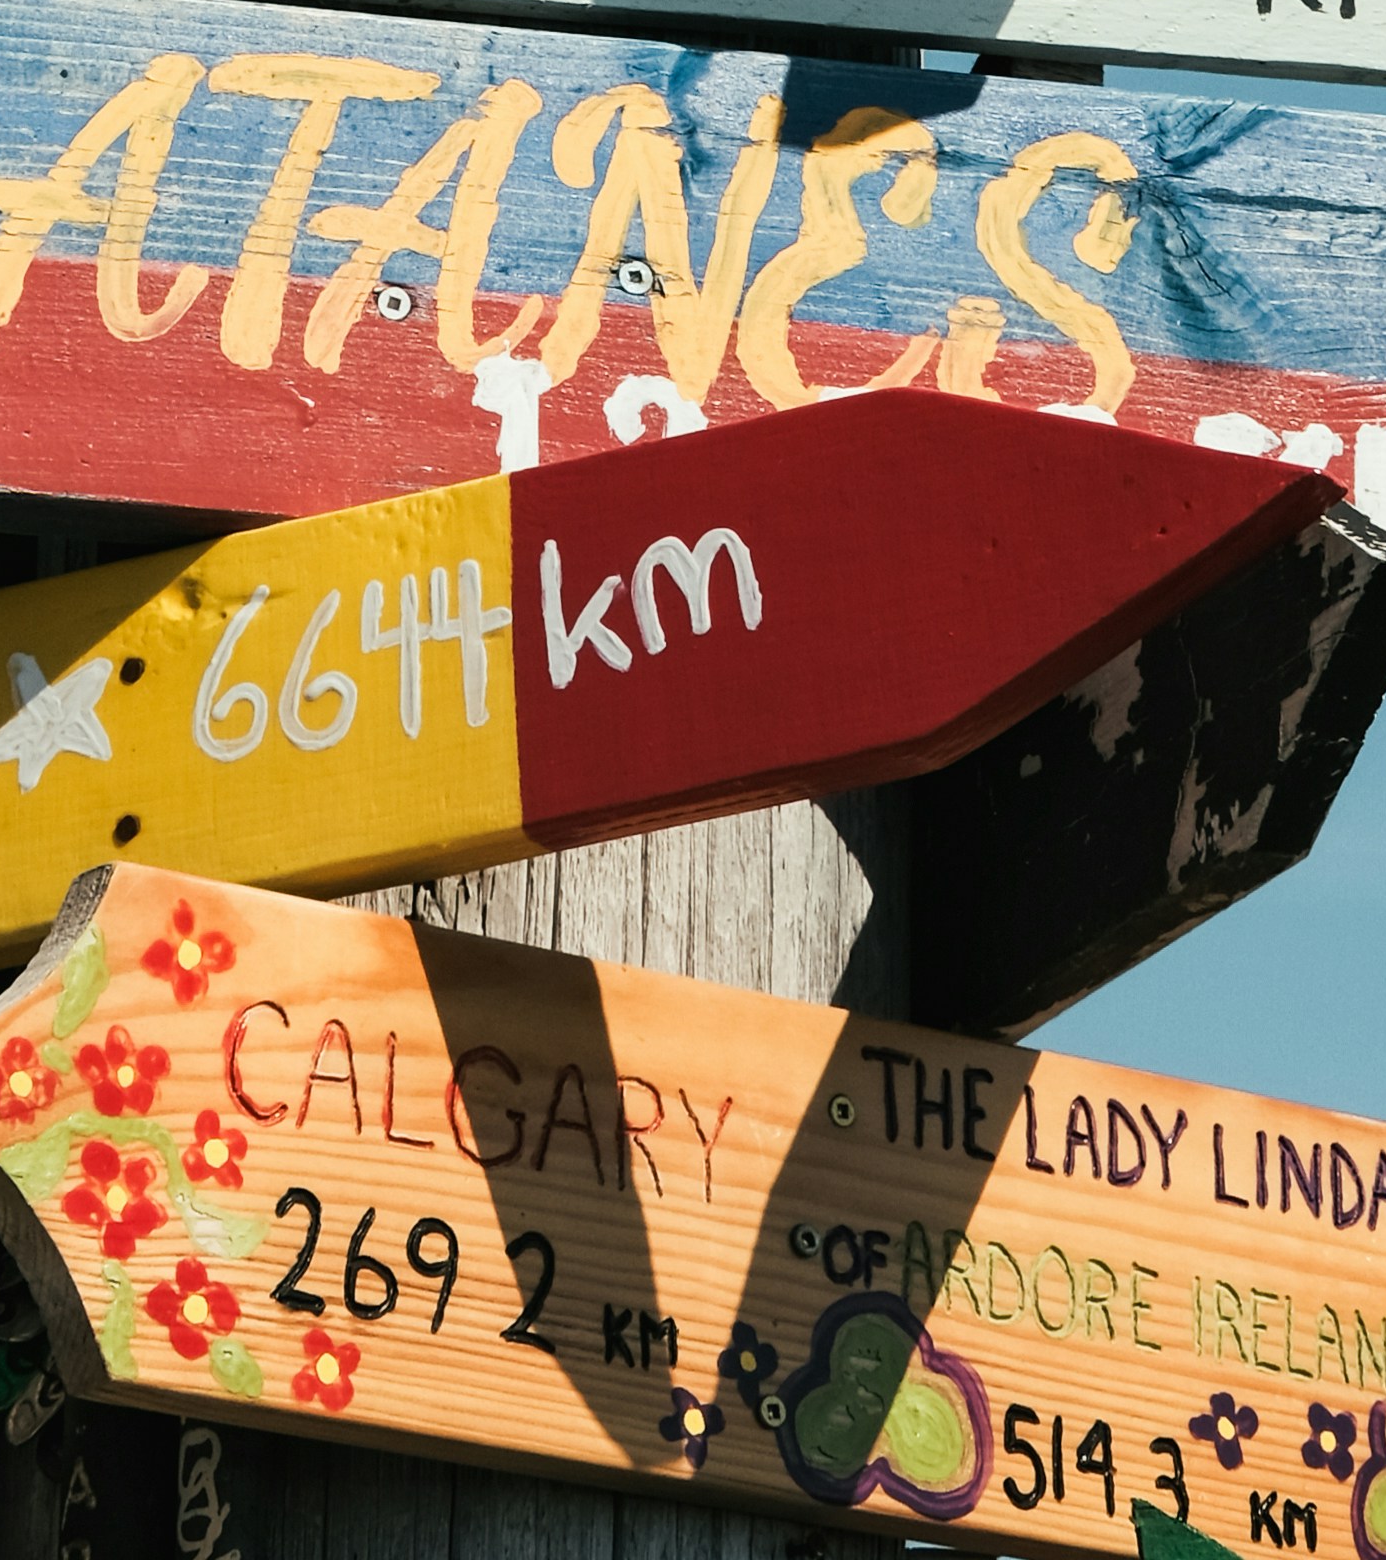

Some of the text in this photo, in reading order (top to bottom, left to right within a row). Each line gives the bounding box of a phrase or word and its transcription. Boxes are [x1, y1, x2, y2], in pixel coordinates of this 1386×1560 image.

[193, 558, 512, 762] 6644
[539, 526, 763, 689] km
[222, 999, 733, 1203] CALGARY
[861, 1045, 996, 1161] THE
[1024, 1083, 1187, 1192] LADY
[602, 1300, 681, 1371] KM
[822, 1224, 890, 1288] OF
[900, 1219, 1163, 1352] ARDORE
[1249, 1491, 1319, 1553] KM
